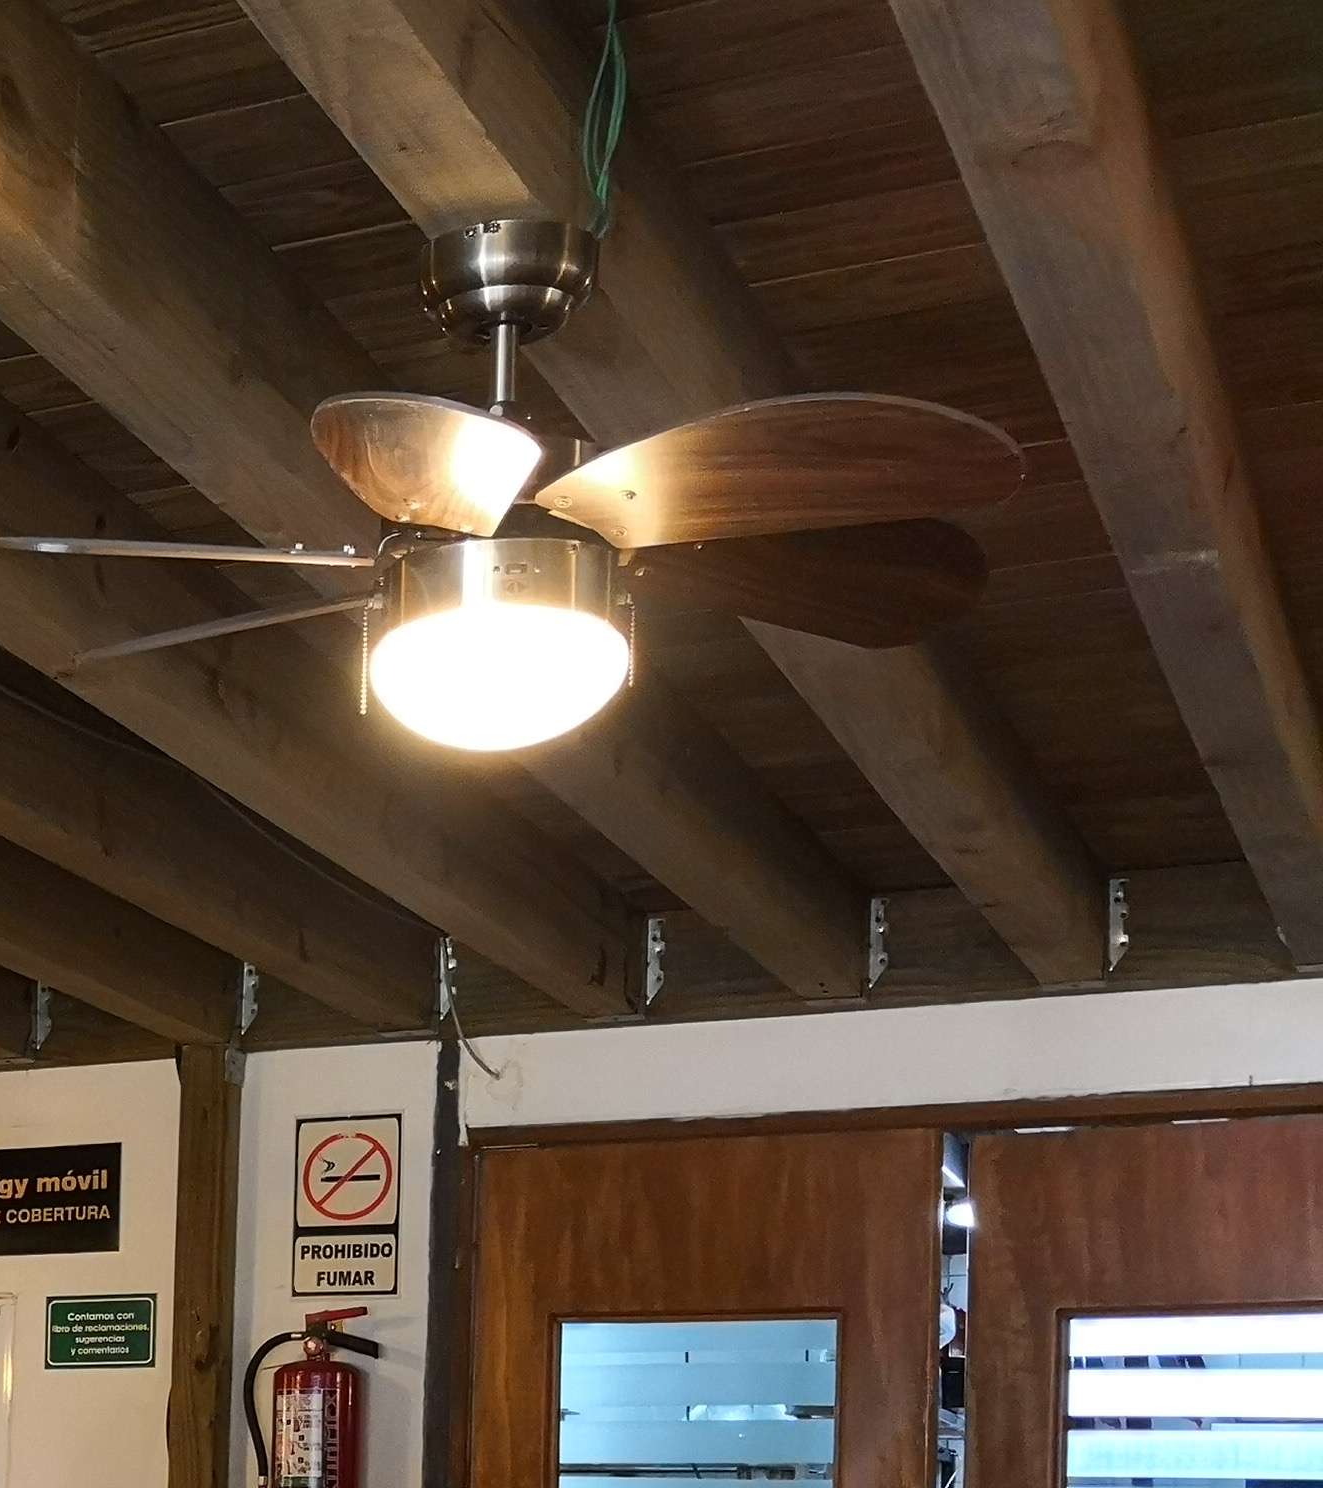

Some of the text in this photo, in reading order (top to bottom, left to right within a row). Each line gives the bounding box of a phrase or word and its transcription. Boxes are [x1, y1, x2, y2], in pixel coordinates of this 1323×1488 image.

[36, 1168, 109, 1193] móvil
[5, 1205, 112, 1224] COBERTURA
[300, 1243, 393, 1260] PROHIBIDO
[317, 1270, 375, 1287] FUMAR
[67, 1312, 134, 1321] Contamos con
[52, 1324, 70, 1333] libro
[72, 1324, 83, 1332] de
[75, 1334, 125, 1345] sugerencias
[77, 1346, 130, 1355] comentarios
